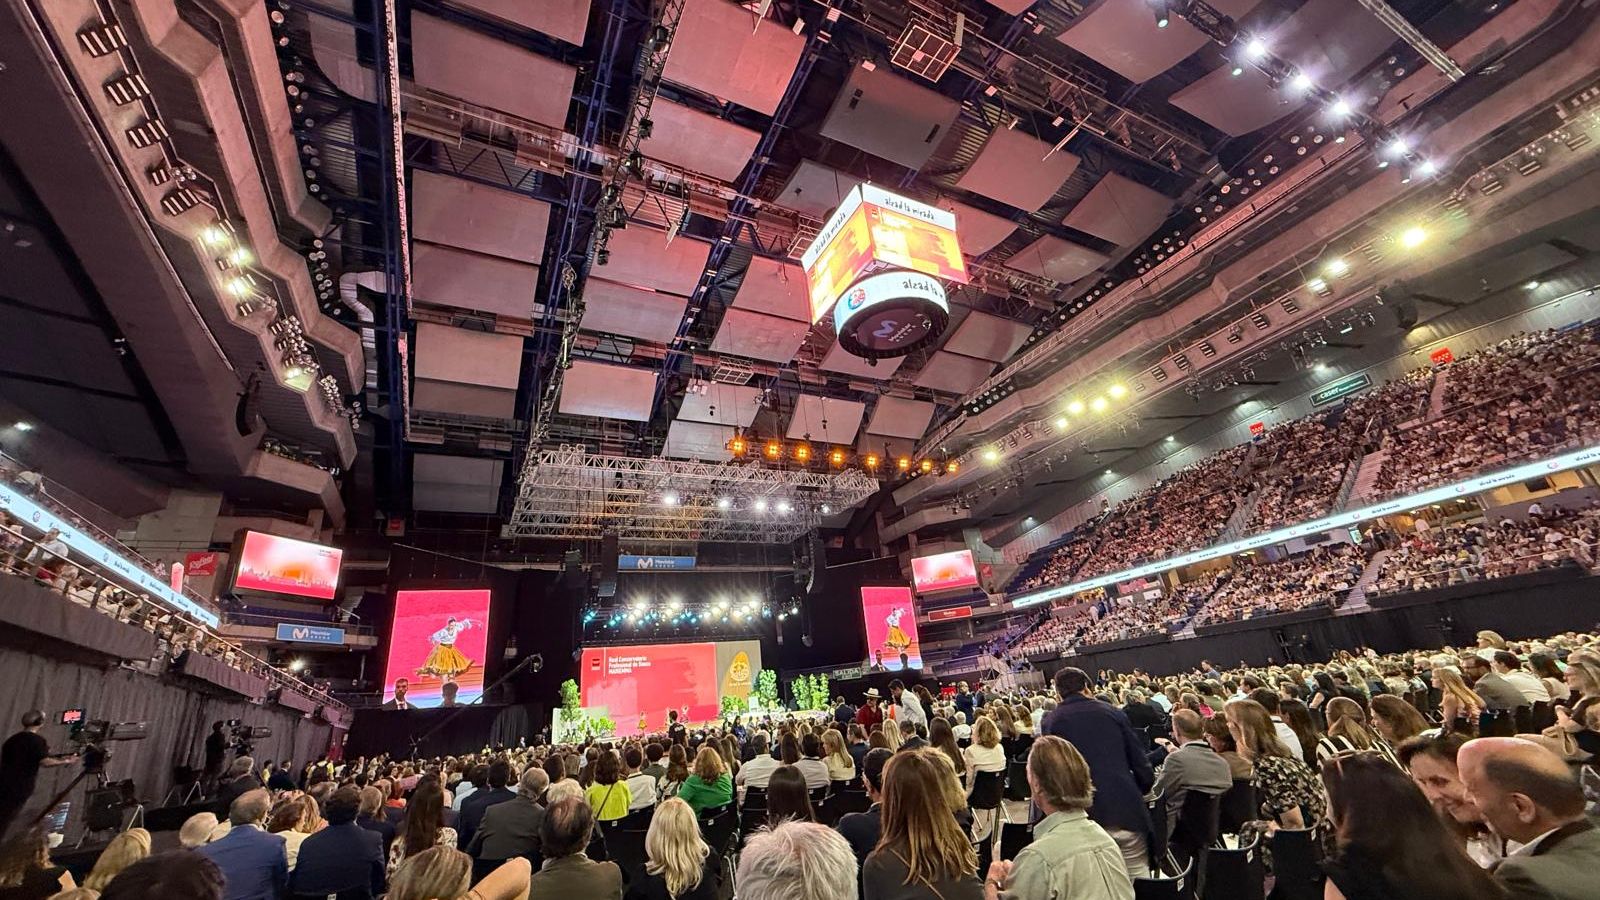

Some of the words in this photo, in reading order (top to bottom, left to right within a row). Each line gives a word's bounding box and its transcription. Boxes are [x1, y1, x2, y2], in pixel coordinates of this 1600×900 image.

[884, 197, 903, 209] alzad
[904, 202, 911, 212] la
[913, 208, 935, 220] mirada
[902, 279, 929, 292] alzad
[1320, 387, 1339, 399] caser
